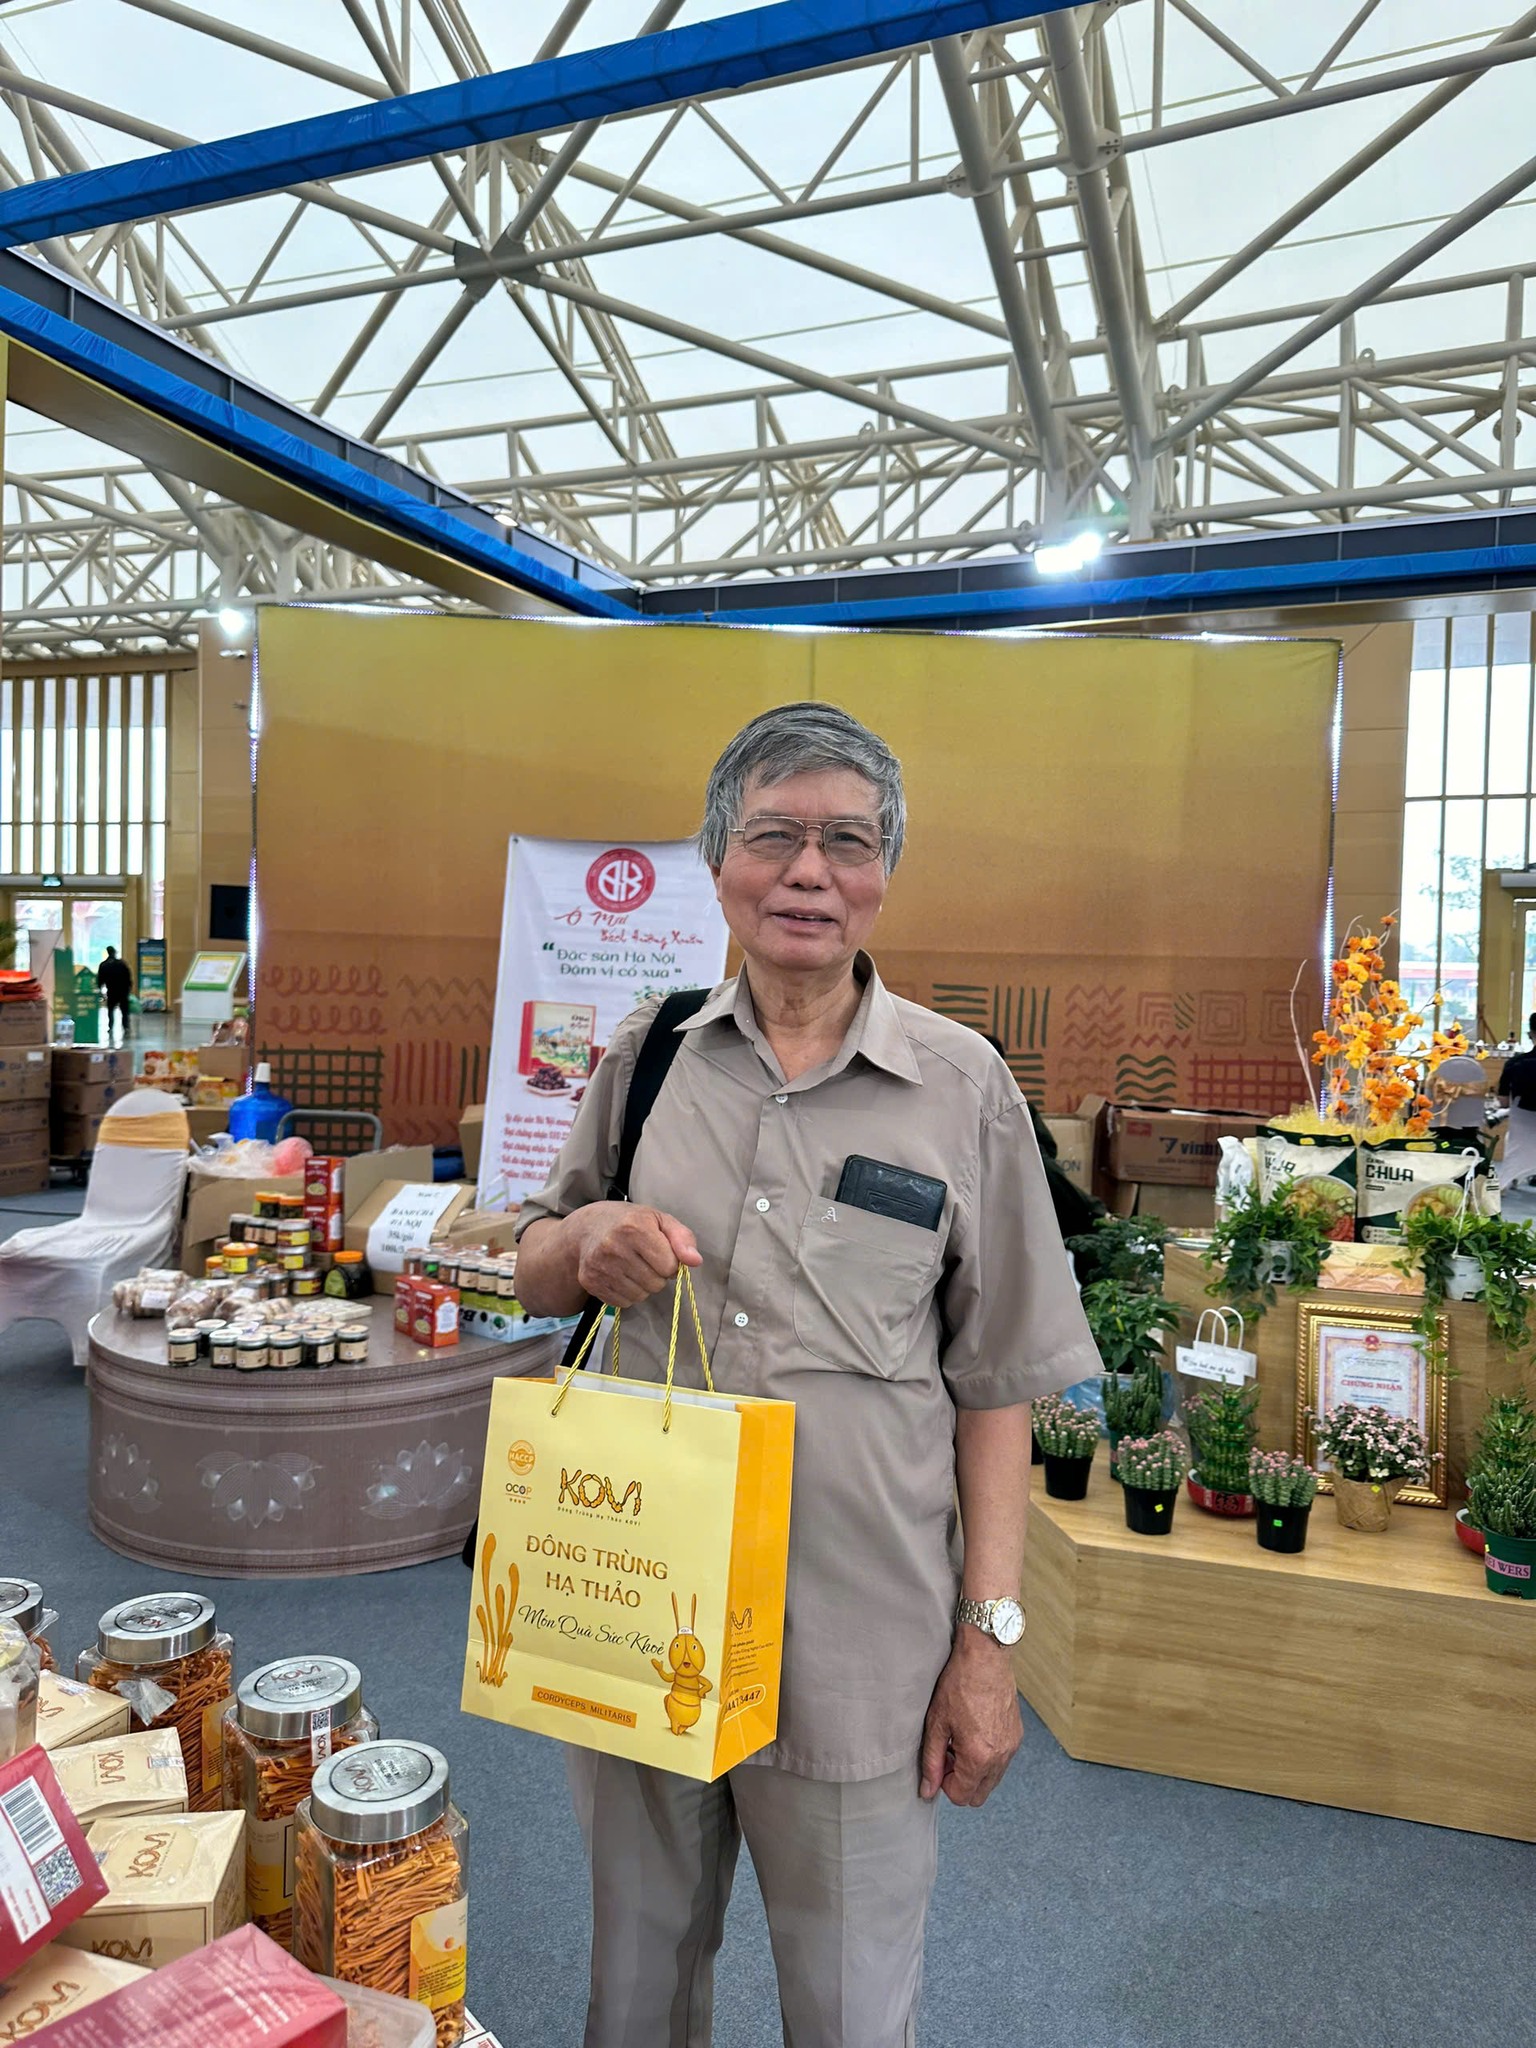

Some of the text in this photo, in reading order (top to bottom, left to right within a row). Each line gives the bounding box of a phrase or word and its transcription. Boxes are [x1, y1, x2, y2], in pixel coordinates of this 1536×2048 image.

[1365, 1164, 1414, 1182] CHUA
[505, 1482, 533, 1496] OCOP
[558, 1467, 643, 1517] KOVI
[526, 1533, 669, 1581] ĐÔNG TRÙNG
[545, 1571, 642, 1609] HẠ THẢO
[518, 1604, 556, 1630] Món
[557, 1614, 594, 1640] Quà
[594, 1623, 625, 1646] Sức
[537, 1691, 632, 1724] CORDYCEPS MILITARIS
[97, 1750, 126, 1785] KOVI
[125, 1832, 171, 1878] KOVI
